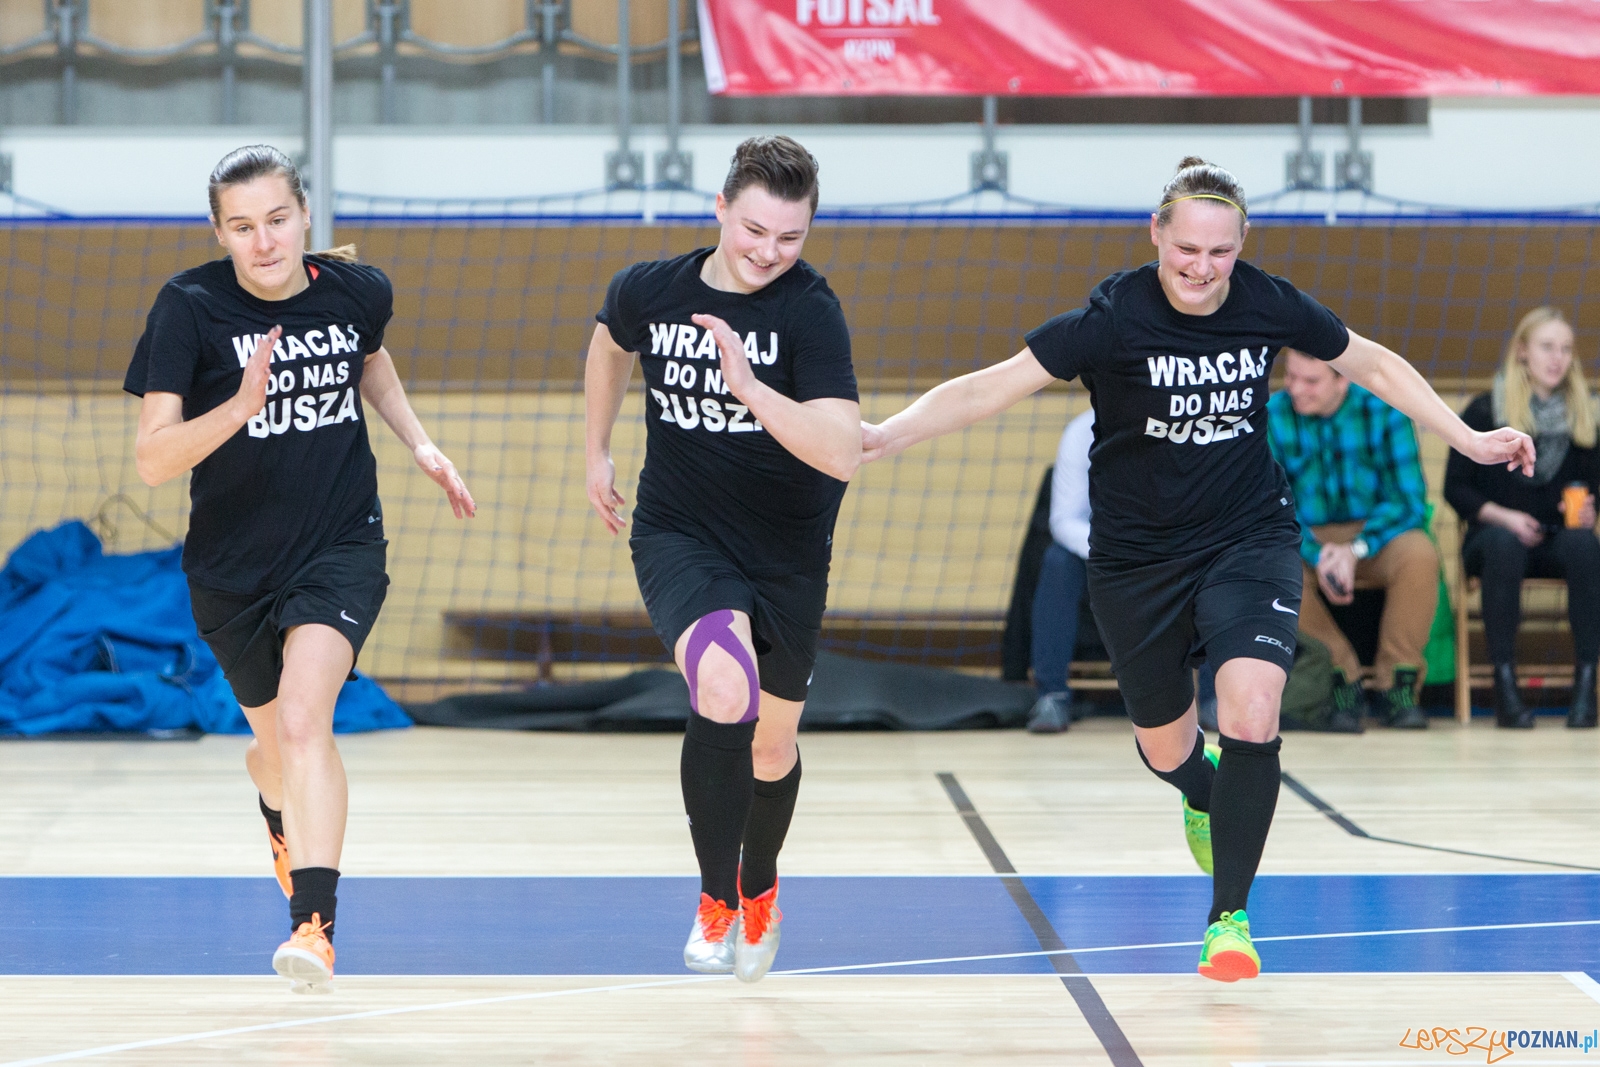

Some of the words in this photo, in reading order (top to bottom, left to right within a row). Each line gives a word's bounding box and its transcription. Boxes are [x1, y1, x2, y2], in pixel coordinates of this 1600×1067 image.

[796, 0, 942, 26] FUTSAL
[232, 324, 360, 368] WRACAJ
[649, 322, 779, 366] WRAAJ
[265, 369, 296, 396] DO
[302, 360, 350, 389] NAS
[663, 359, 697, 390] DO
[1147, 346, 1269, 387] WRACAJ
[247, 386, 359, 439] BUSZA
[650, 387, 763, 433] BUSZ
[1169, 393, 1202, 417] DO
[1209, 387, 1254, 414] NAS
[1144, 411, 1257, 446] BUSZA
